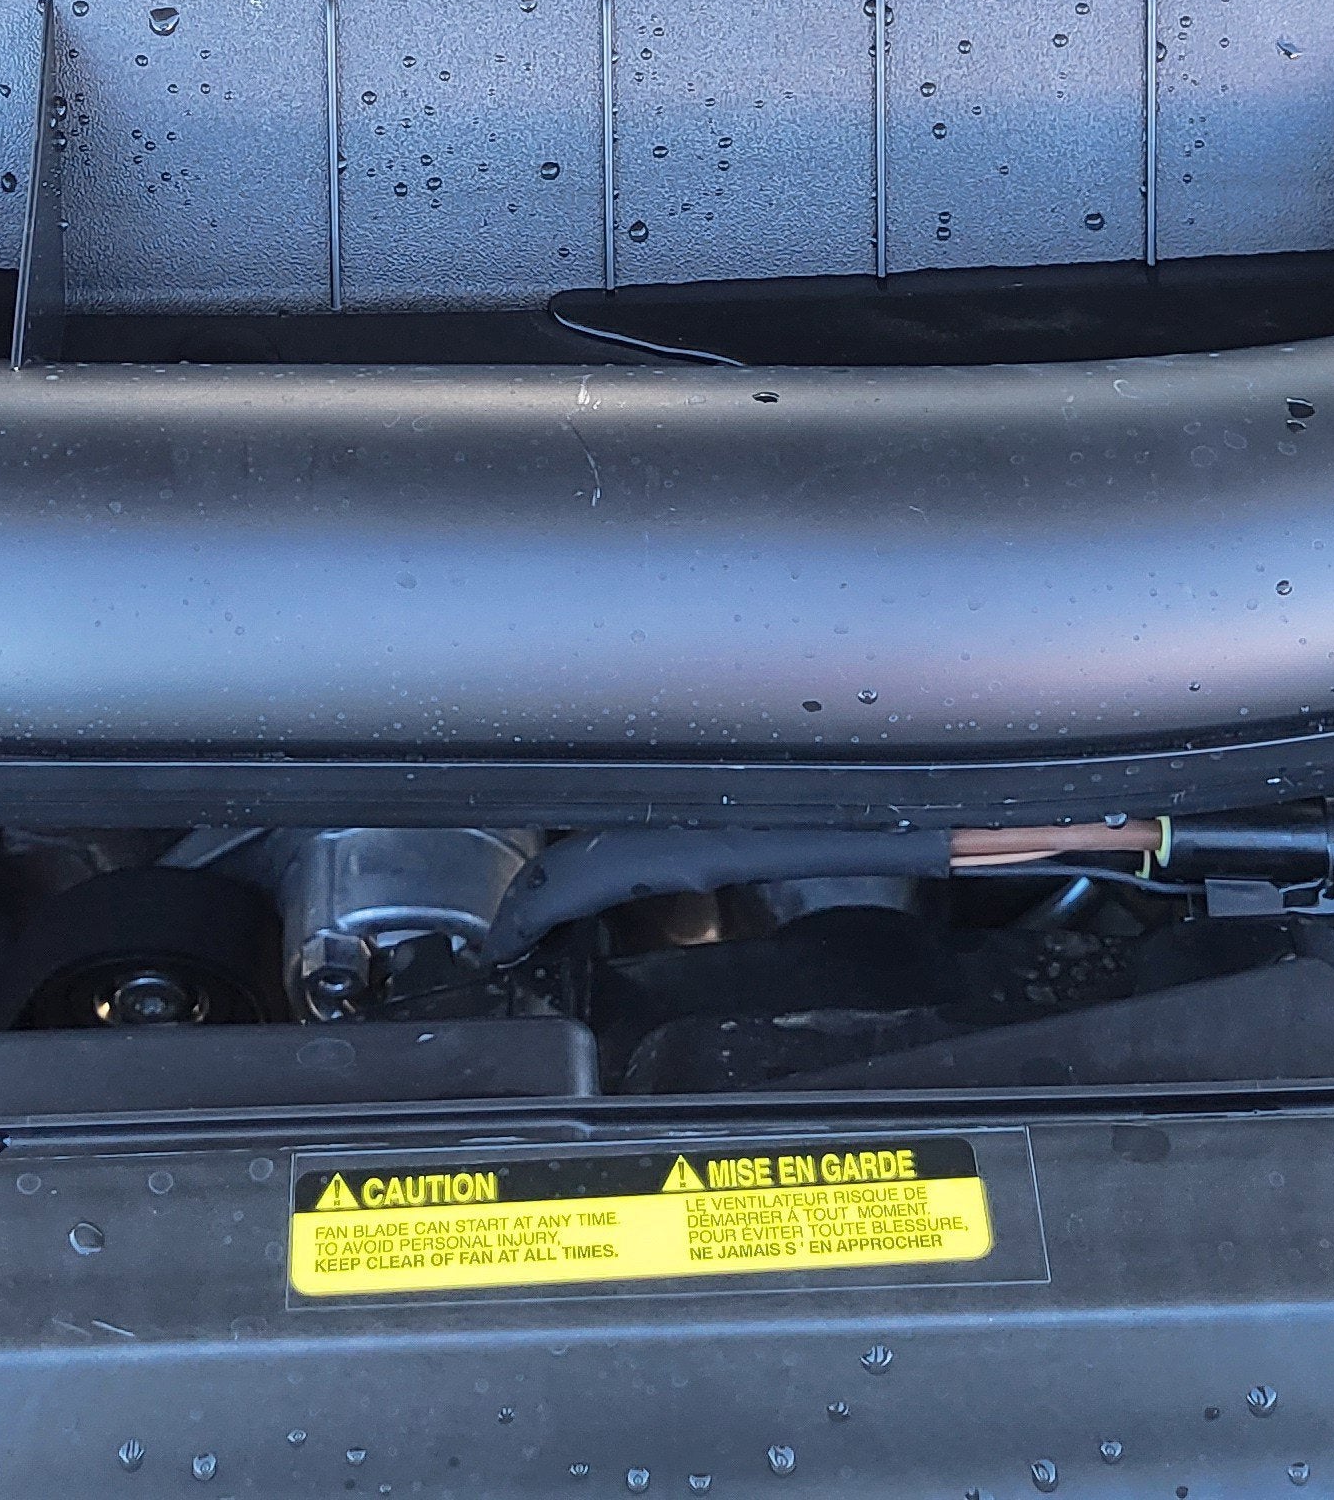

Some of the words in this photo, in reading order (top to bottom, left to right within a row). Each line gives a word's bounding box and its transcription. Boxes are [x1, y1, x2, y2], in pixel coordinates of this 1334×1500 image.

[708, 1157, 772, 1188] MISE
[779, 1155, 815, 1184] EN
[821, 1150, 916, 1183] GARDE
[362, 1171, 497, 1208] CAUTION
[686, 1198, 704, 1213] LE
[711, 1192, 828, 1210] VENTILATEUR
[835, 1188, 898, 1204] RISQUE
[904, 1186, 927, 1201] DE
[316, 1226, 348, 1240] FAN
[354, 1223, 409, 1239] BLADE
[414, 1220, 450, 1235] CAN
[456, 1217, 508, 1233] START
[513, 1216, 533, 1230] AT
[537, 1214, 572, 1228] ANY
[575, 1212, 621, 1226] TIME.
[803, 1207, 849, 1222] TOUT
[858, 1203, 931, 1219] MOMENT.
[316, 1242, 338, 1257] TO
[341, 1239, 394, 1255] AVOID
[400, 1234, 493, 1252] PERSONAL
[497, 1230, 562, 1247] INJURY,
[689, 1229, 737, 1244] POUR
[743, 1223, 804, 1241] ÉVITER
[811, 1223, 866, 1238] TOUTE
[872, 1217, 969, 1234] BLESSURE,
[315, 1257, 360, 1272] KEEP
[367, 1254, 424, 1270] CLEAR
[431, 1253, 454, 1267] OF
[459, 1250, 495, 1265] FAN
[499, 1249, 520, 1263] AT
[524, 1247, 557, 1262] ALL
[563, 1244, 619, 1260] TIMES.
[690, 1246, 713, 1261] NE
[718, 1242, 781, 1259] JAMAIS
[837, 1235, 943, 1253] APPROCHER
